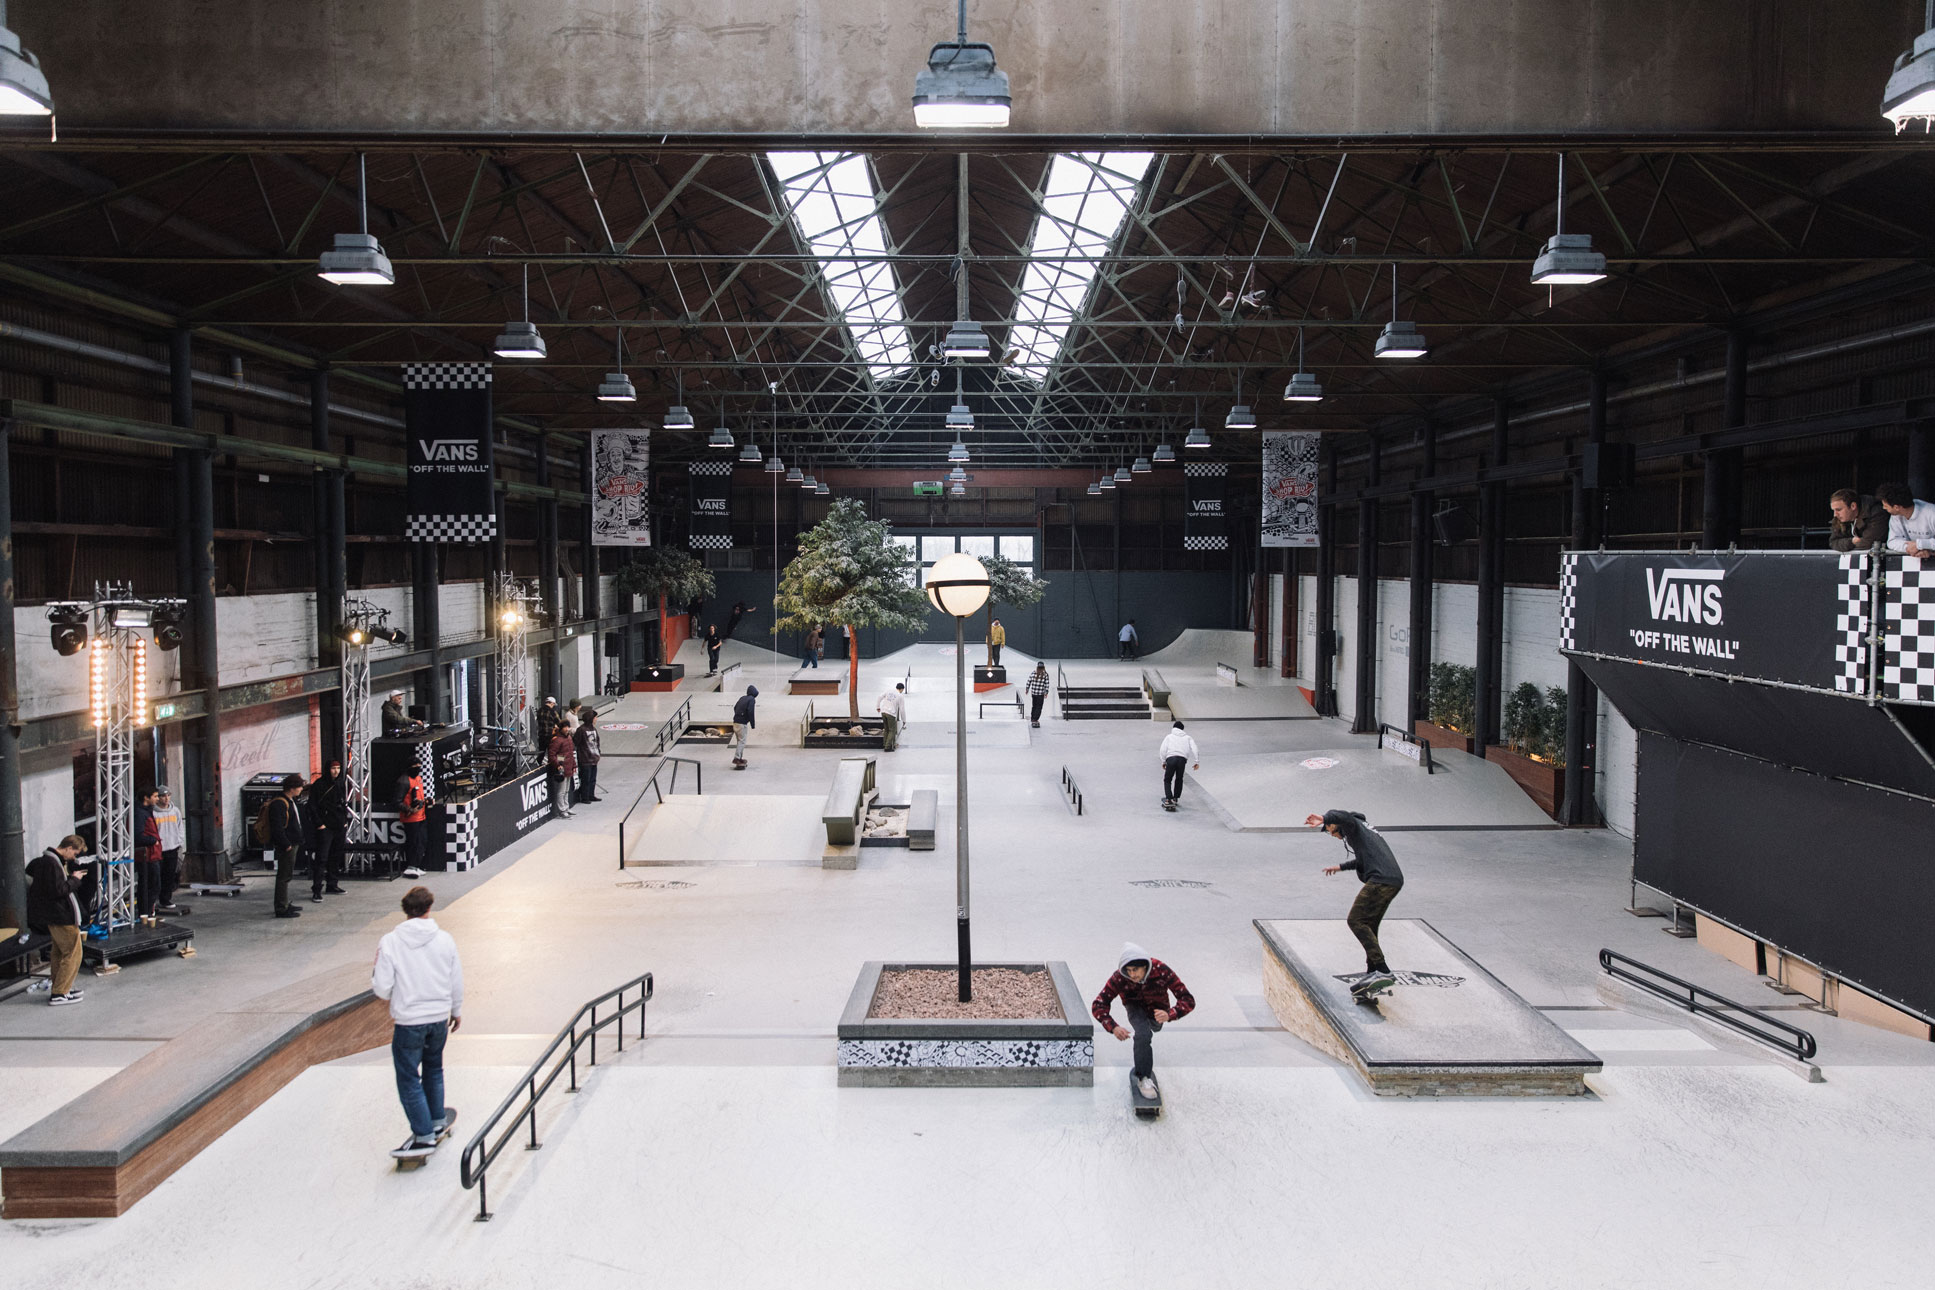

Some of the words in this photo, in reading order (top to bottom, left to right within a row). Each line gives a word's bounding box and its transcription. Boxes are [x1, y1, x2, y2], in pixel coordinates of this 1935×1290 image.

[418, 439, 479, 461] VANS
[436, 465, 456, 473] THE
[457, 465, 489, 473] WALL"
[697, 498, 727, 510] VANS
[1192, 499, 1222, 511] VANS
[1645, 567, 1726, 626] VANS
[1629, 629, 1661, 649] "OFF
[1663, 633, 1690, 653] THE
[1692, 636, 1740, 660] WALL"
[520, 772, 548, 812] VANS
[346, 812, 407, 845] ANS
[515, 816, 529, 831] "OFF
[528, 810, 539, 825] THE
[538, 802, 553, 819] WALL"
